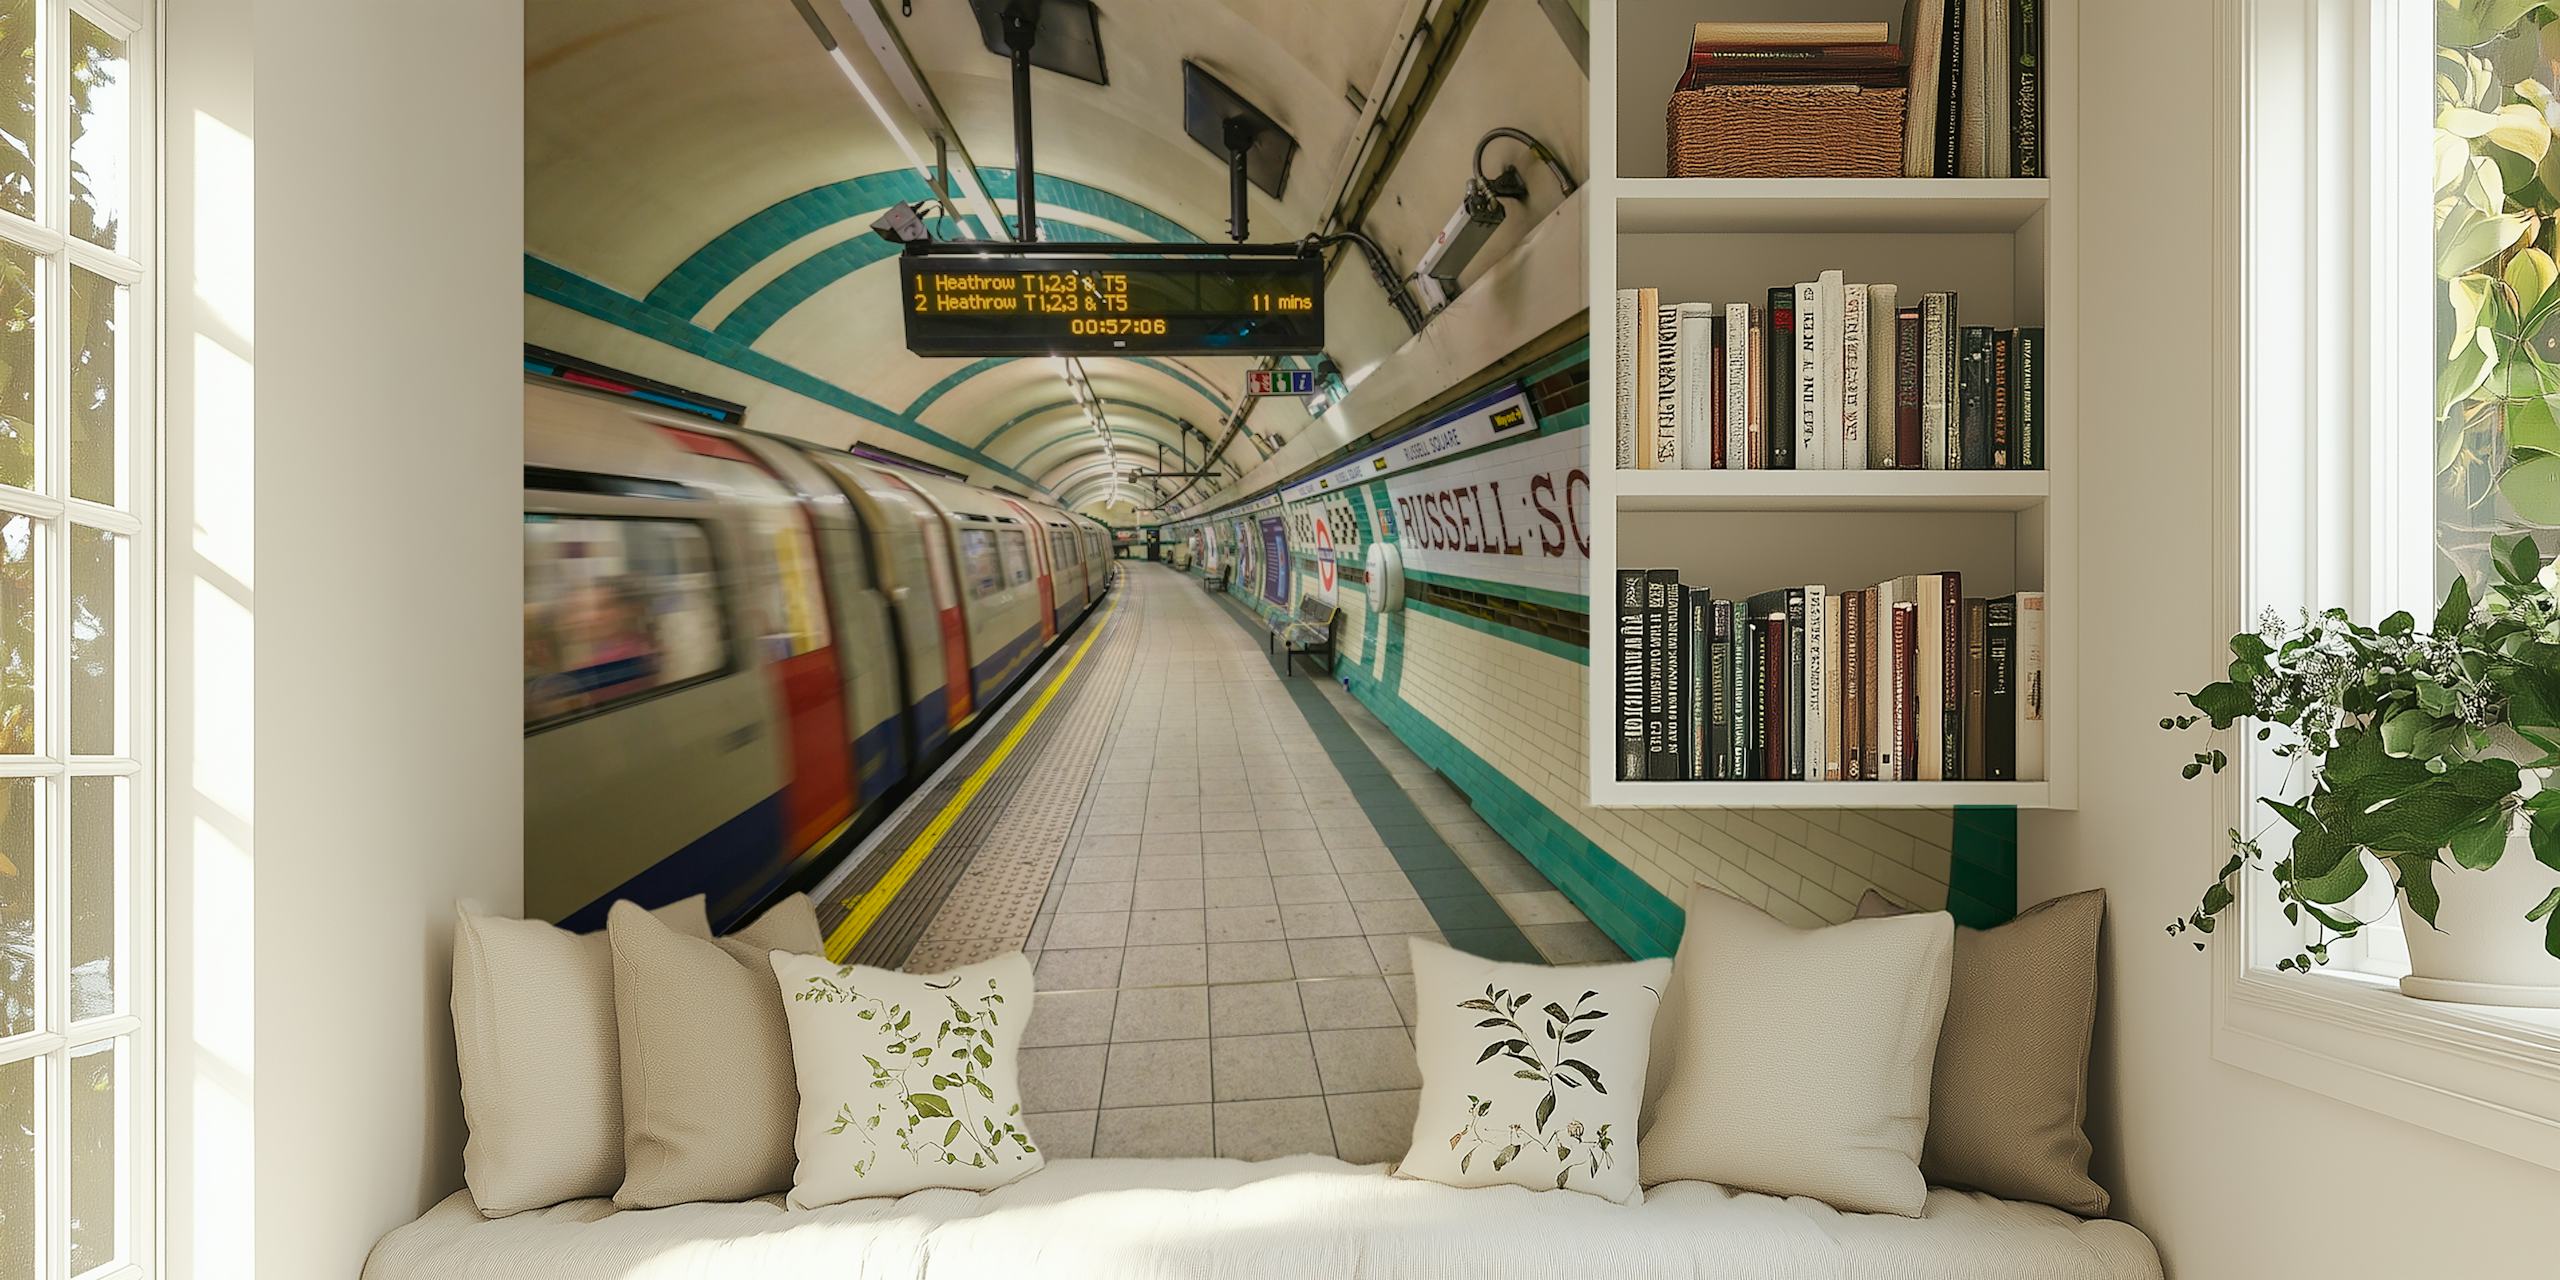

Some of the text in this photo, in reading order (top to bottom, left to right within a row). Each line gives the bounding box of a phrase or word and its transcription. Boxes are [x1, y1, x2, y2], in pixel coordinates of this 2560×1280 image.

[915, 274, 1128, 294] 1 Heathrow T1,2,3 & T5
[914, 293, 1313, 314] 2 Heathrow T1,2,3 & T5 11 mins
[1070, 318, 1167, 336] 00:57:06
[1429, 428, 1460, 453] SQUARE
